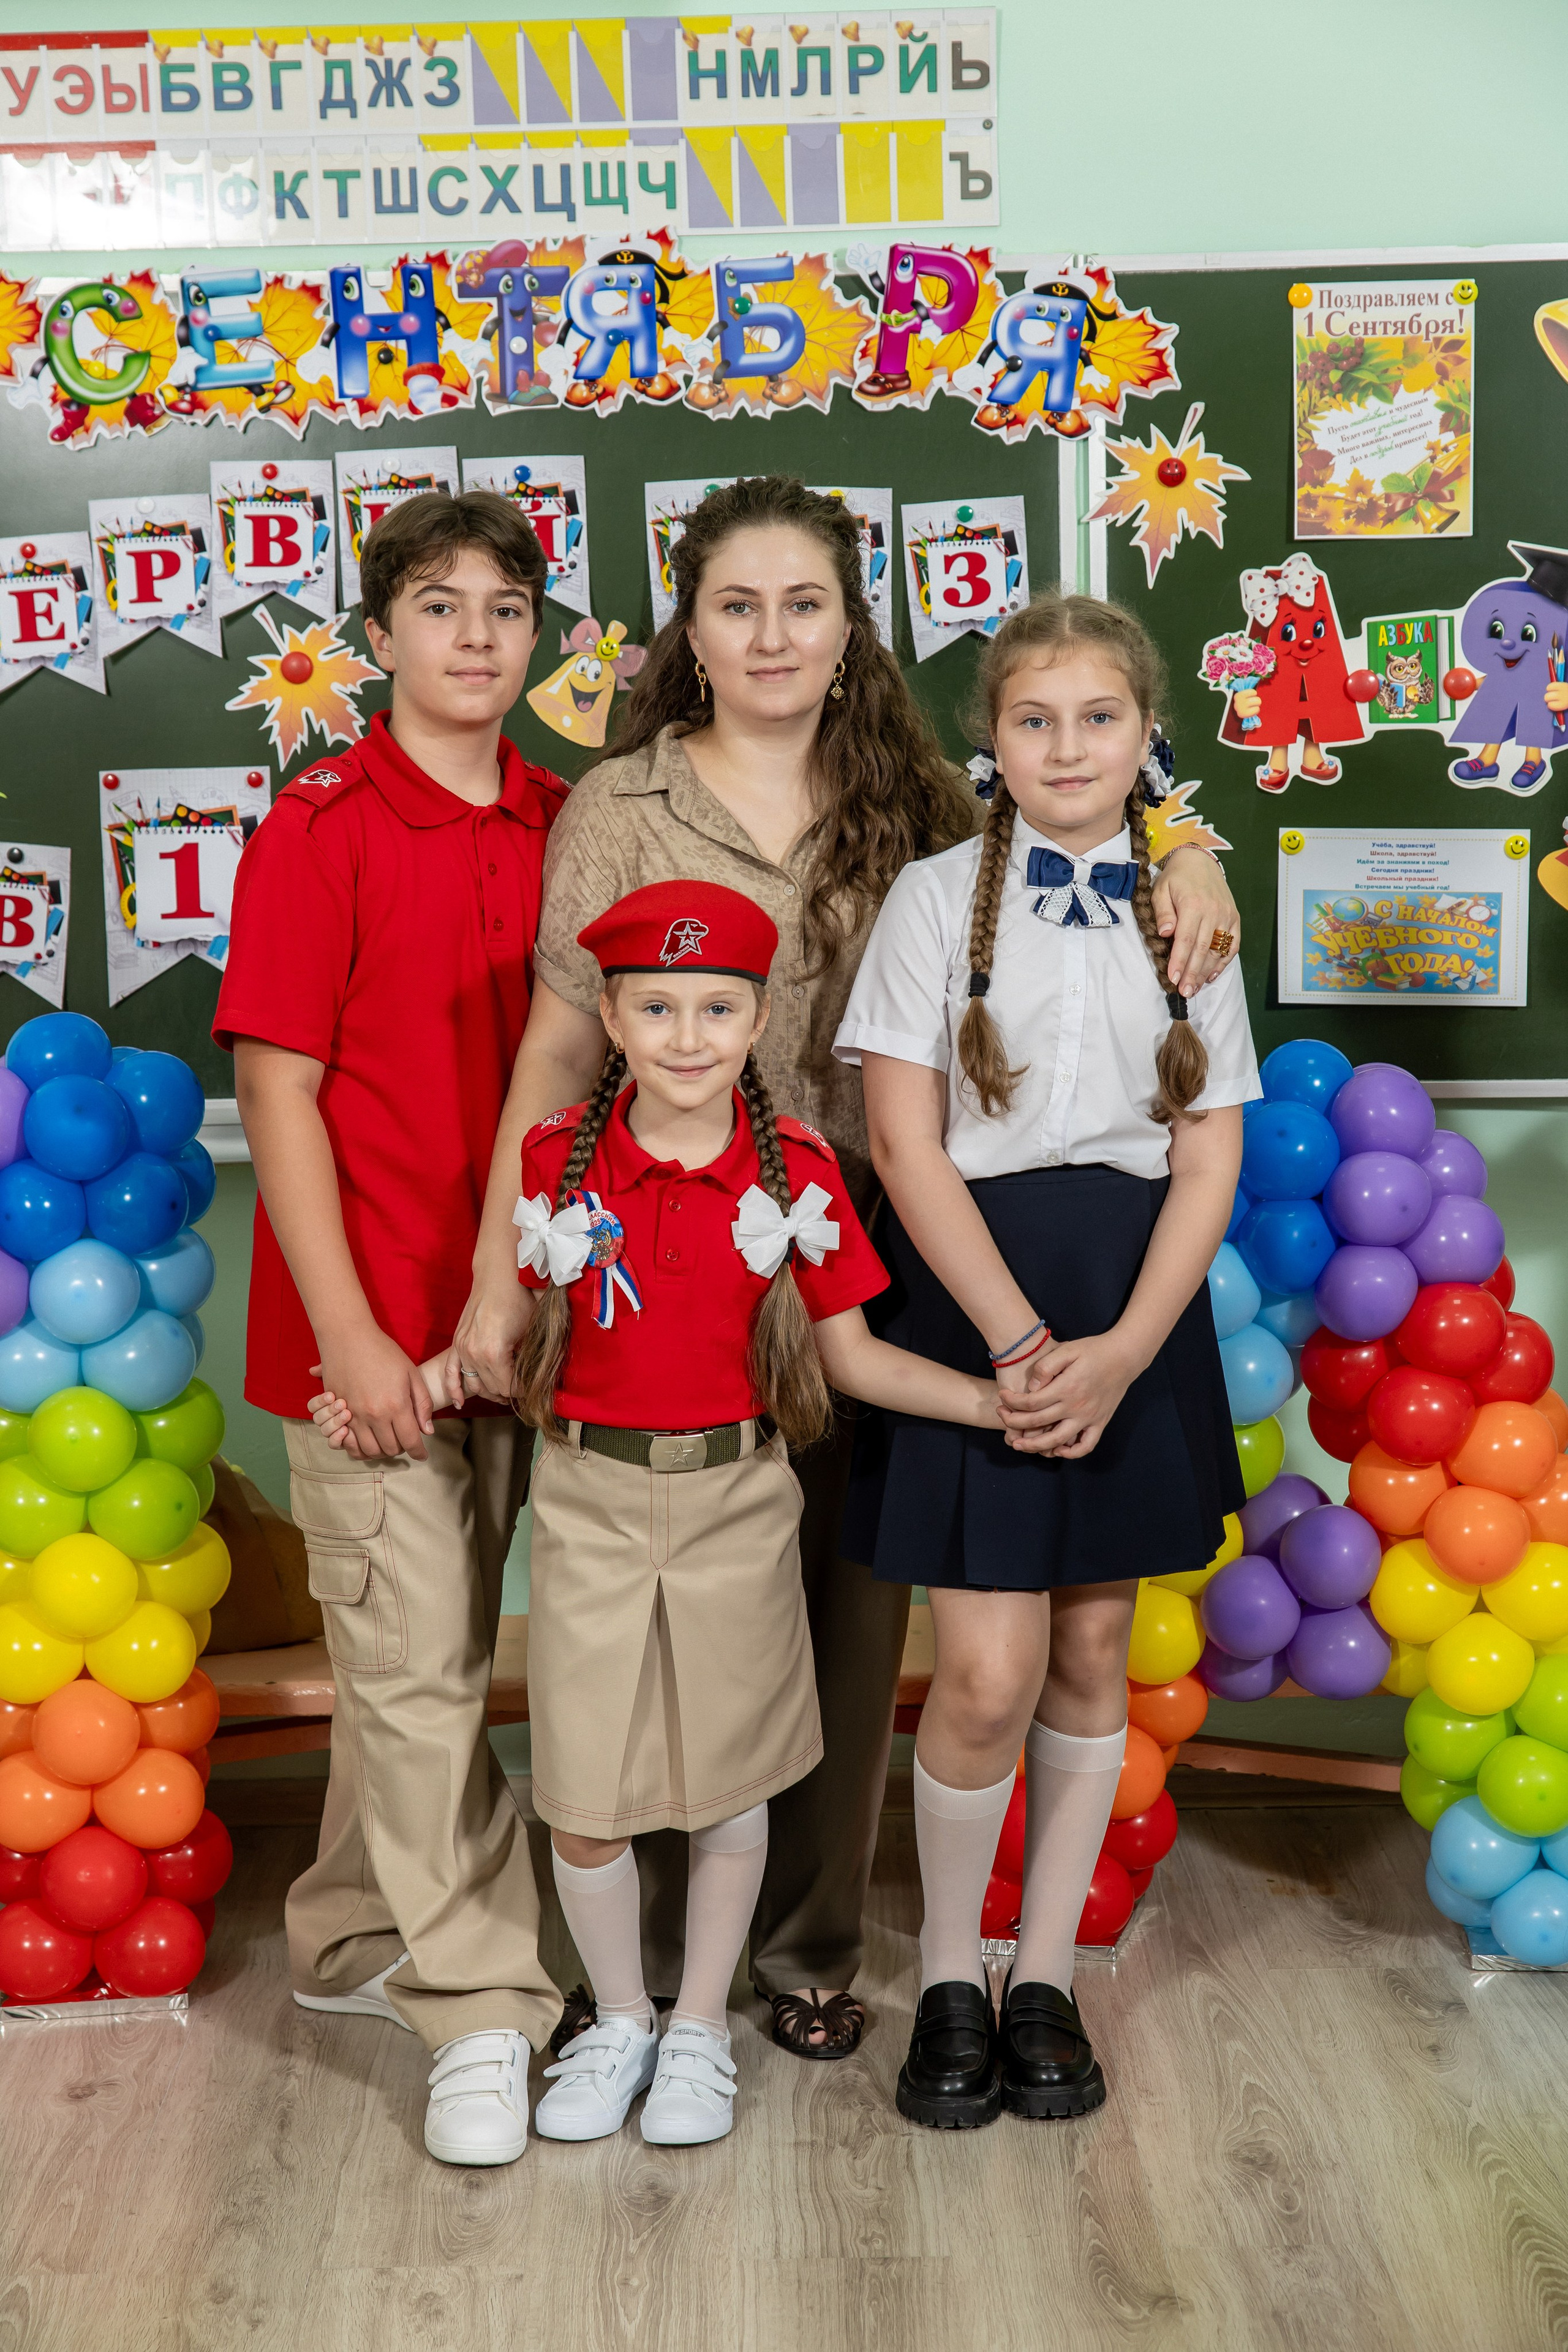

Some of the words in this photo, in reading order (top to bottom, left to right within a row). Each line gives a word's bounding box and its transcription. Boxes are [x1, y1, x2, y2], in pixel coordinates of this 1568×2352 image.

[1319, 290, 1439, 312] Поздравляем
[1446, 292, 1453, 306] с
[43, 243, 1088, 412] СЕНТЯБРЯ
[1303, 312, 1315, 337] 1
[1325, 308, 1464, 341] Сентября!
[1328, 424, 1349, 435] Пусть
[1395, 397, 1428, 412] чудесным
[1341, 432, 1360, 443] Будет
[1362, 427, 1376, 436] этот
[1410, 409, 1423, 419] год!
[1337, 445, 1360, 456] Много
[1362, 435, 1392, 448] важных,
[1393, 420, 1433, 437] интересных
[1350, 455, 1363, 464] Дел
[1395, 432, 1428, 448] принесет!
[1379, 621, 1433, 647] АЗБУКА
[159, 843, 214, 919] 1
[1374, 900, 1393, 919] С
[1396, 904, 1498, 938] НАЧАЛОМ
[1311, 925, 1481, 957] УЧЕБНОГО
[1384, 952, 1475, 979] ГОДА!
[589, 1212, 616, 1225] ЛАССНИК
[590, 1218, 601, 1227] 025
